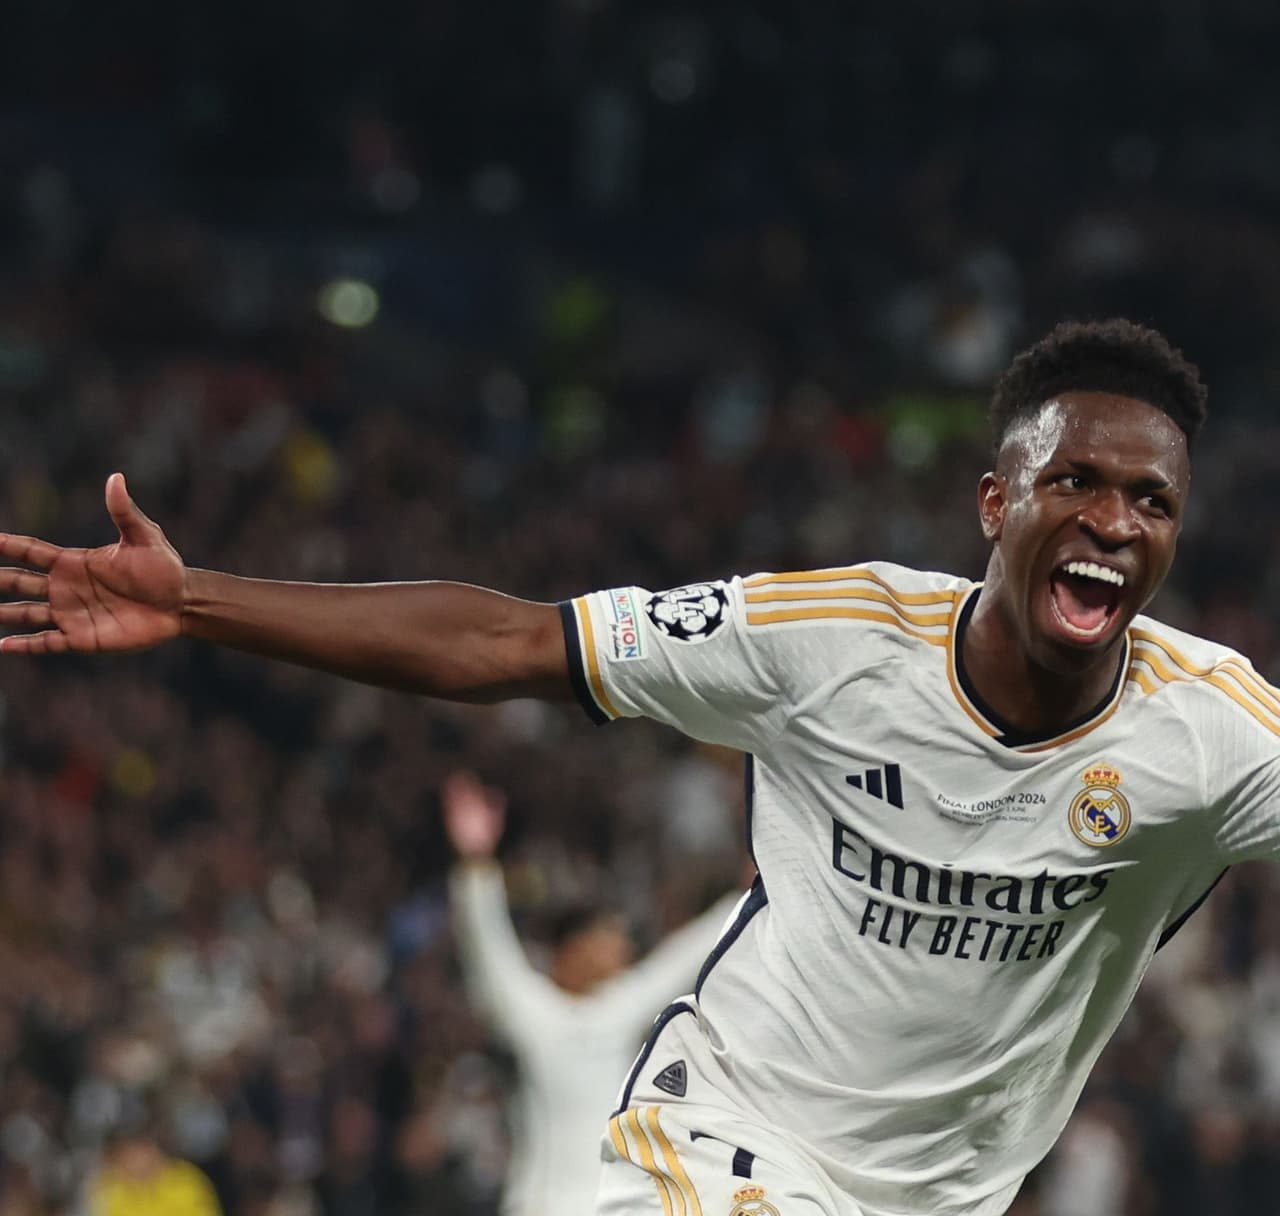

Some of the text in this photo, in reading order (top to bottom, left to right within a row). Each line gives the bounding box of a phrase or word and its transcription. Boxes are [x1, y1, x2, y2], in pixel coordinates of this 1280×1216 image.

[971, 794, 1016, 812] LONDON
[1018, 793, 1047, 804] 2024
[832, 817, 1116, 914] Emirates
[858, 897, 1065, 962] FLY BETTER
